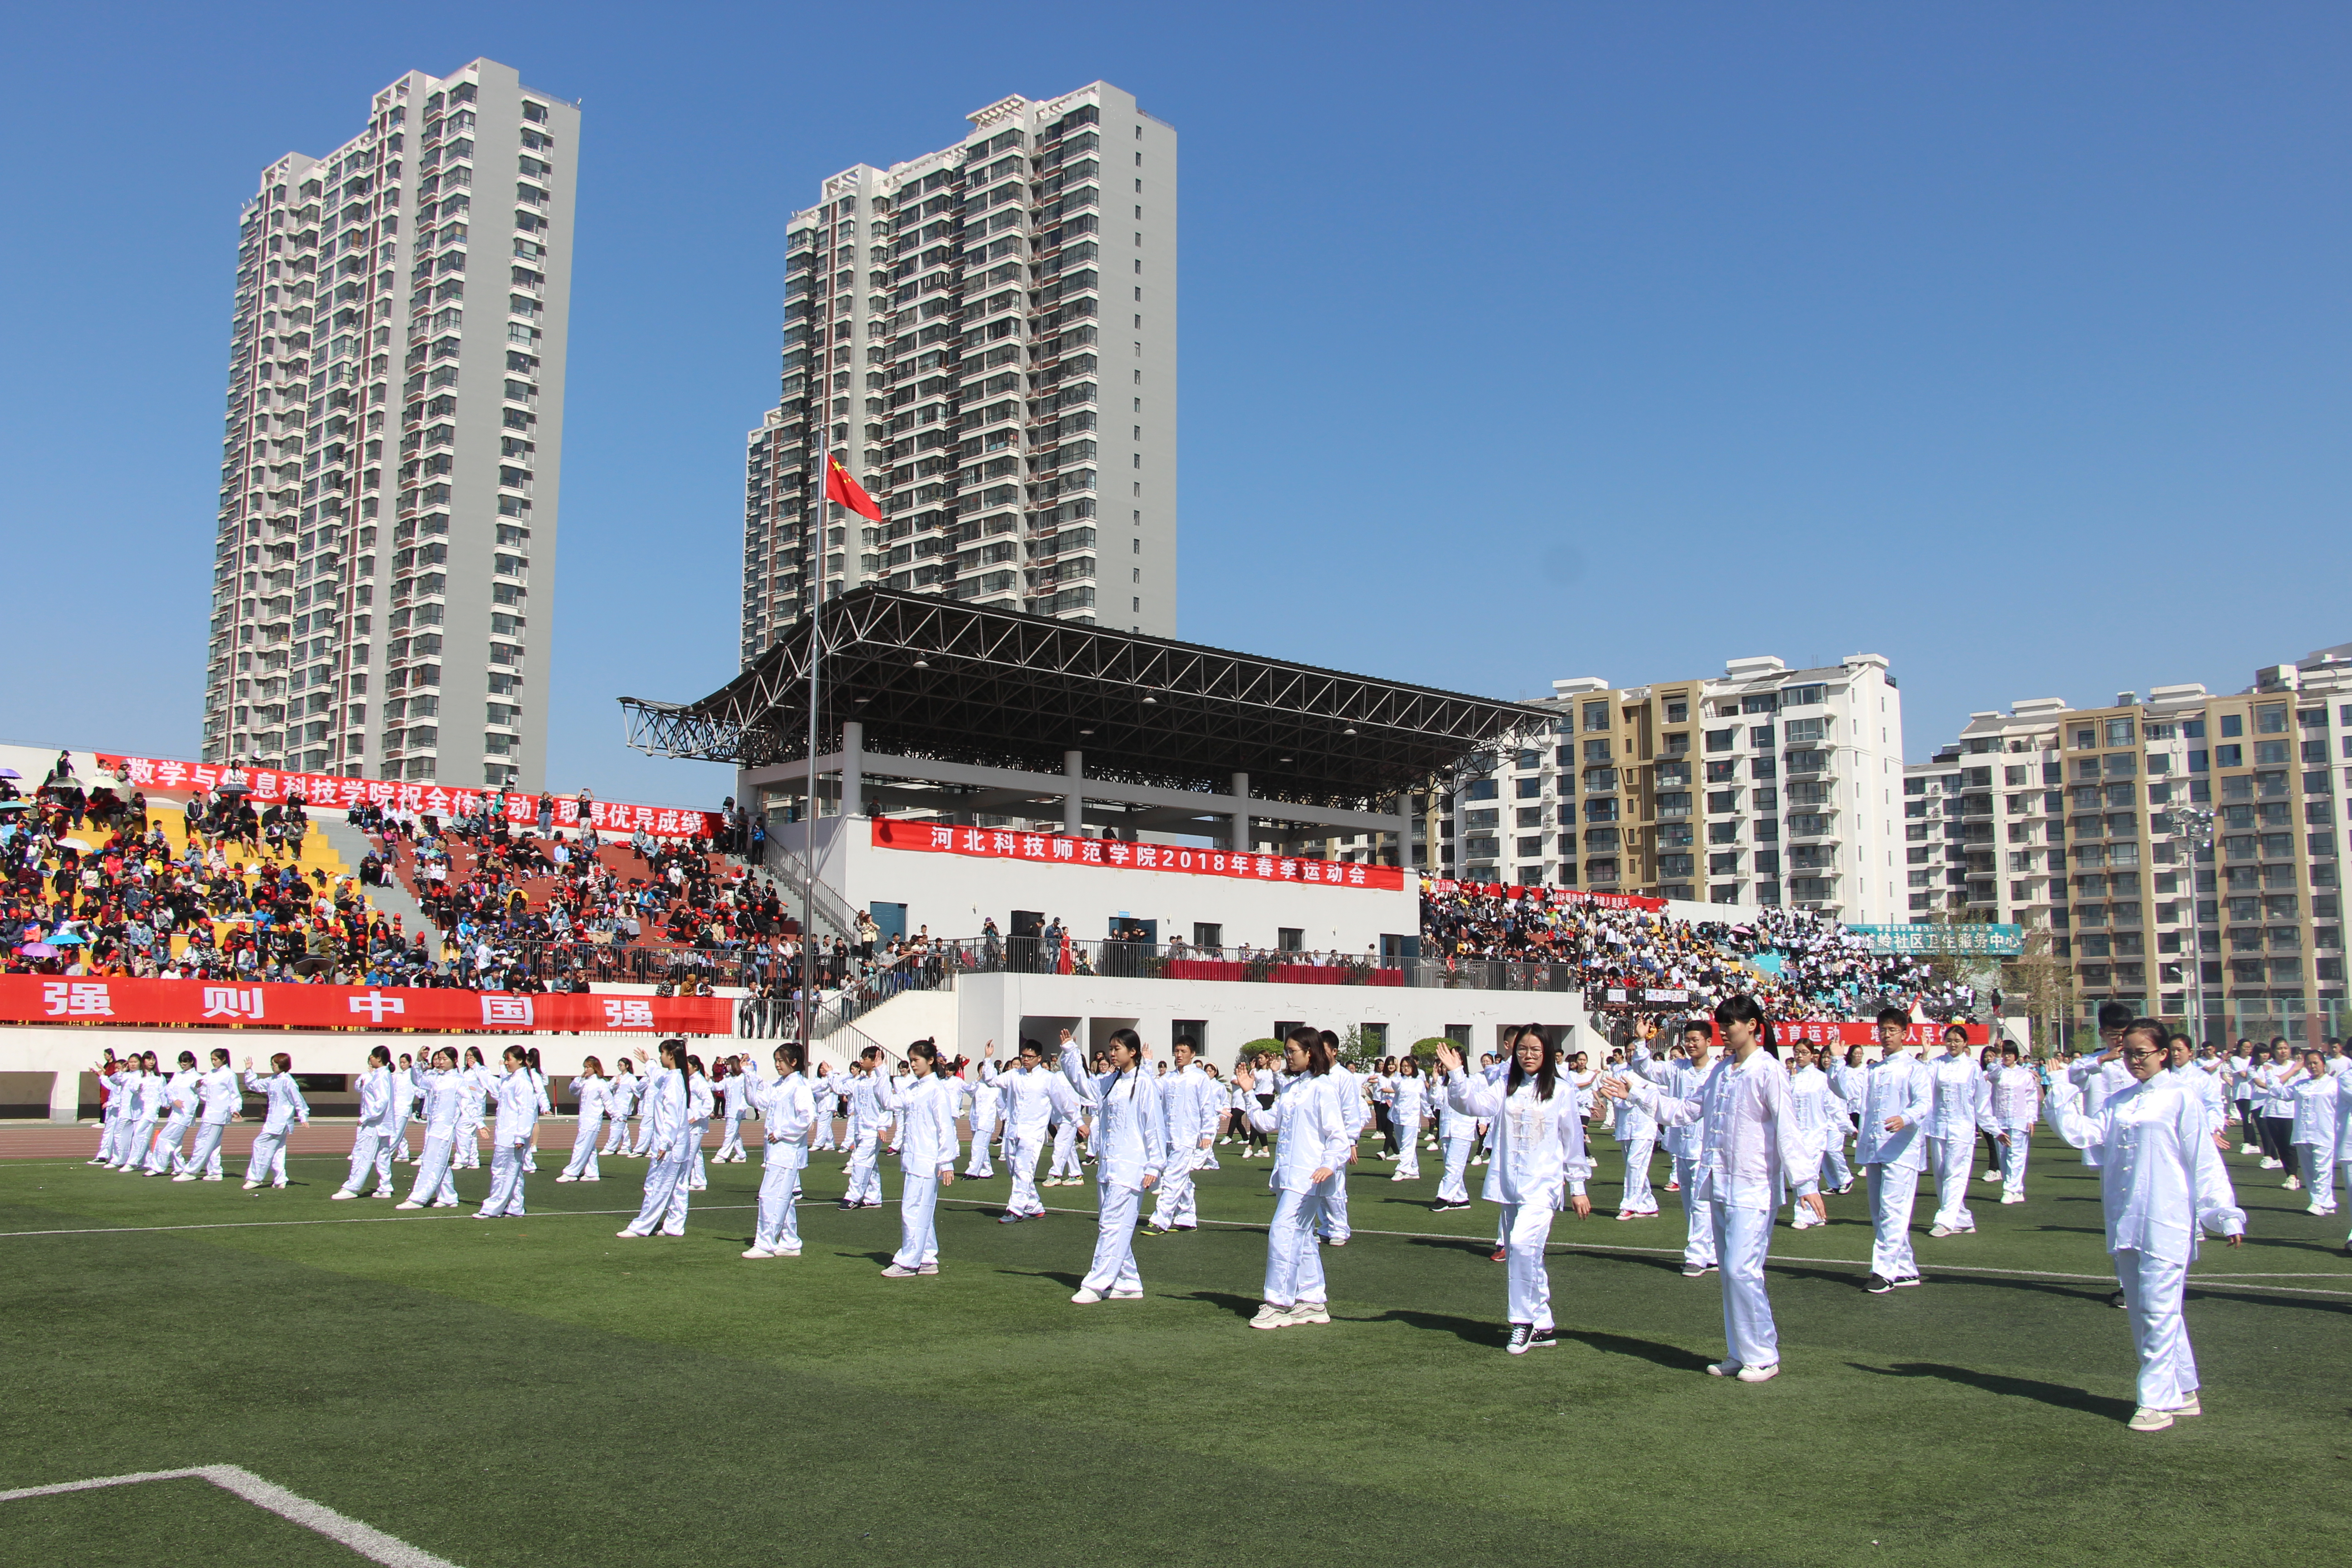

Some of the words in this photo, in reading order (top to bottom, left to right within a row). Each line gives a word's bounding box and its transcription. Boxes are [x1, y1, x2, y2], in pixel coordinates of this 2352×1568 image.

[126, 758, 703, 834] 数学与息科技学院祝全体动取得优异成绩
[931, 826, 1366, 885] 河北科技师范学院2018年春季运动会
[1436, 880, 1455, 891] 全力以
[43, 981, 655, 1028] 强则中国强
